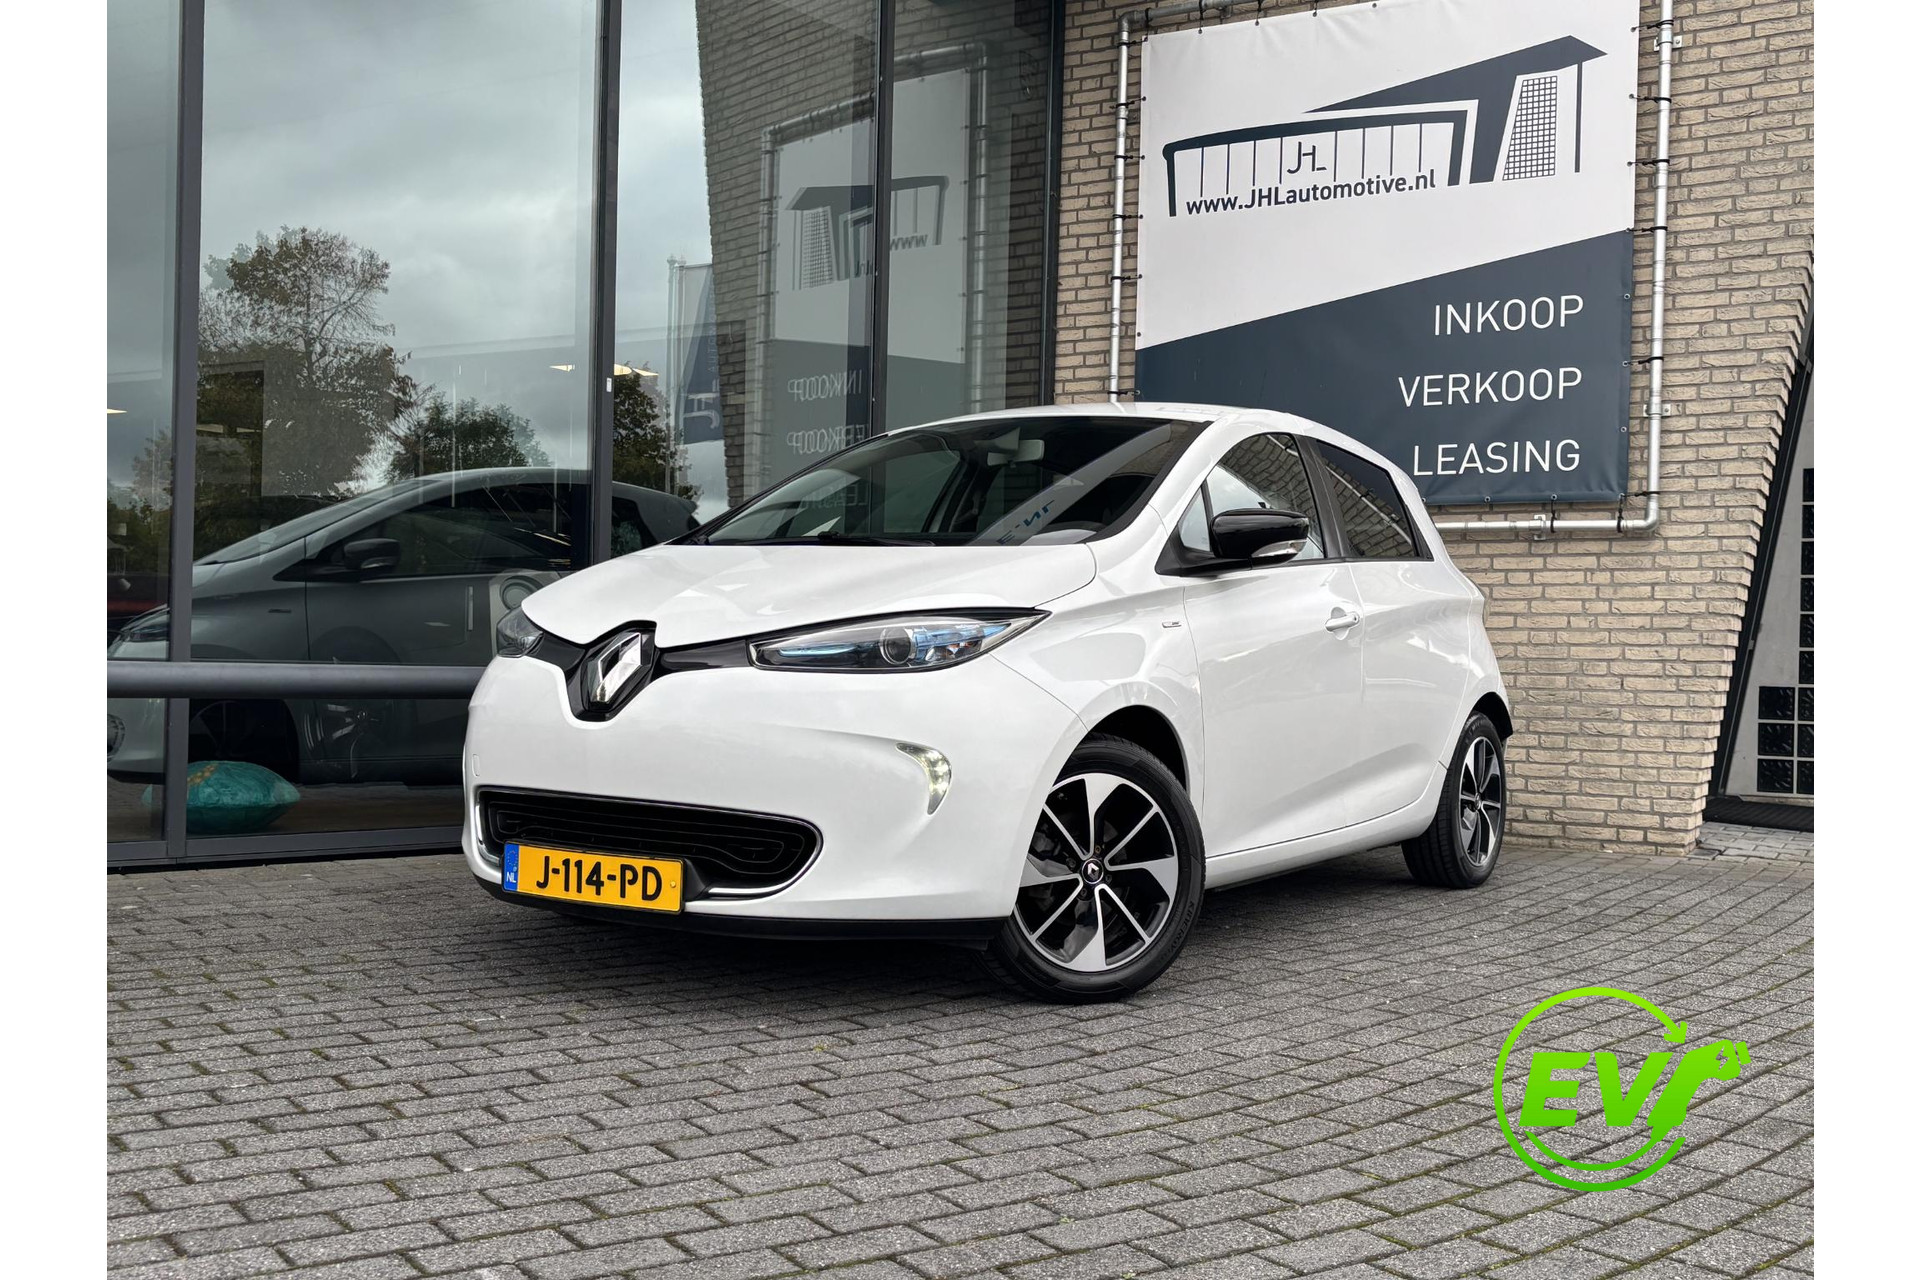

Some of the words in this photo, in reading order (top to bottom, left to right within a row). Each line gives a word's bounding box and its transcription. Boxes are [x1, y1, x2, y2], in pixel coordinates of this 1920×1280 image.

[1286, 141, 1327, 174] JHL
[1186, 168, 1436, 215] www.JHLautomotive.nl
[1434, 294, 1584, 336] INKOOP
[1398, 367, 1583, 407] VERKOOP
[1413, 439, 1580, 476] LEASING
[506, 872, 517, 884] NL
[536, 855, 663, 902] J-114-PD
